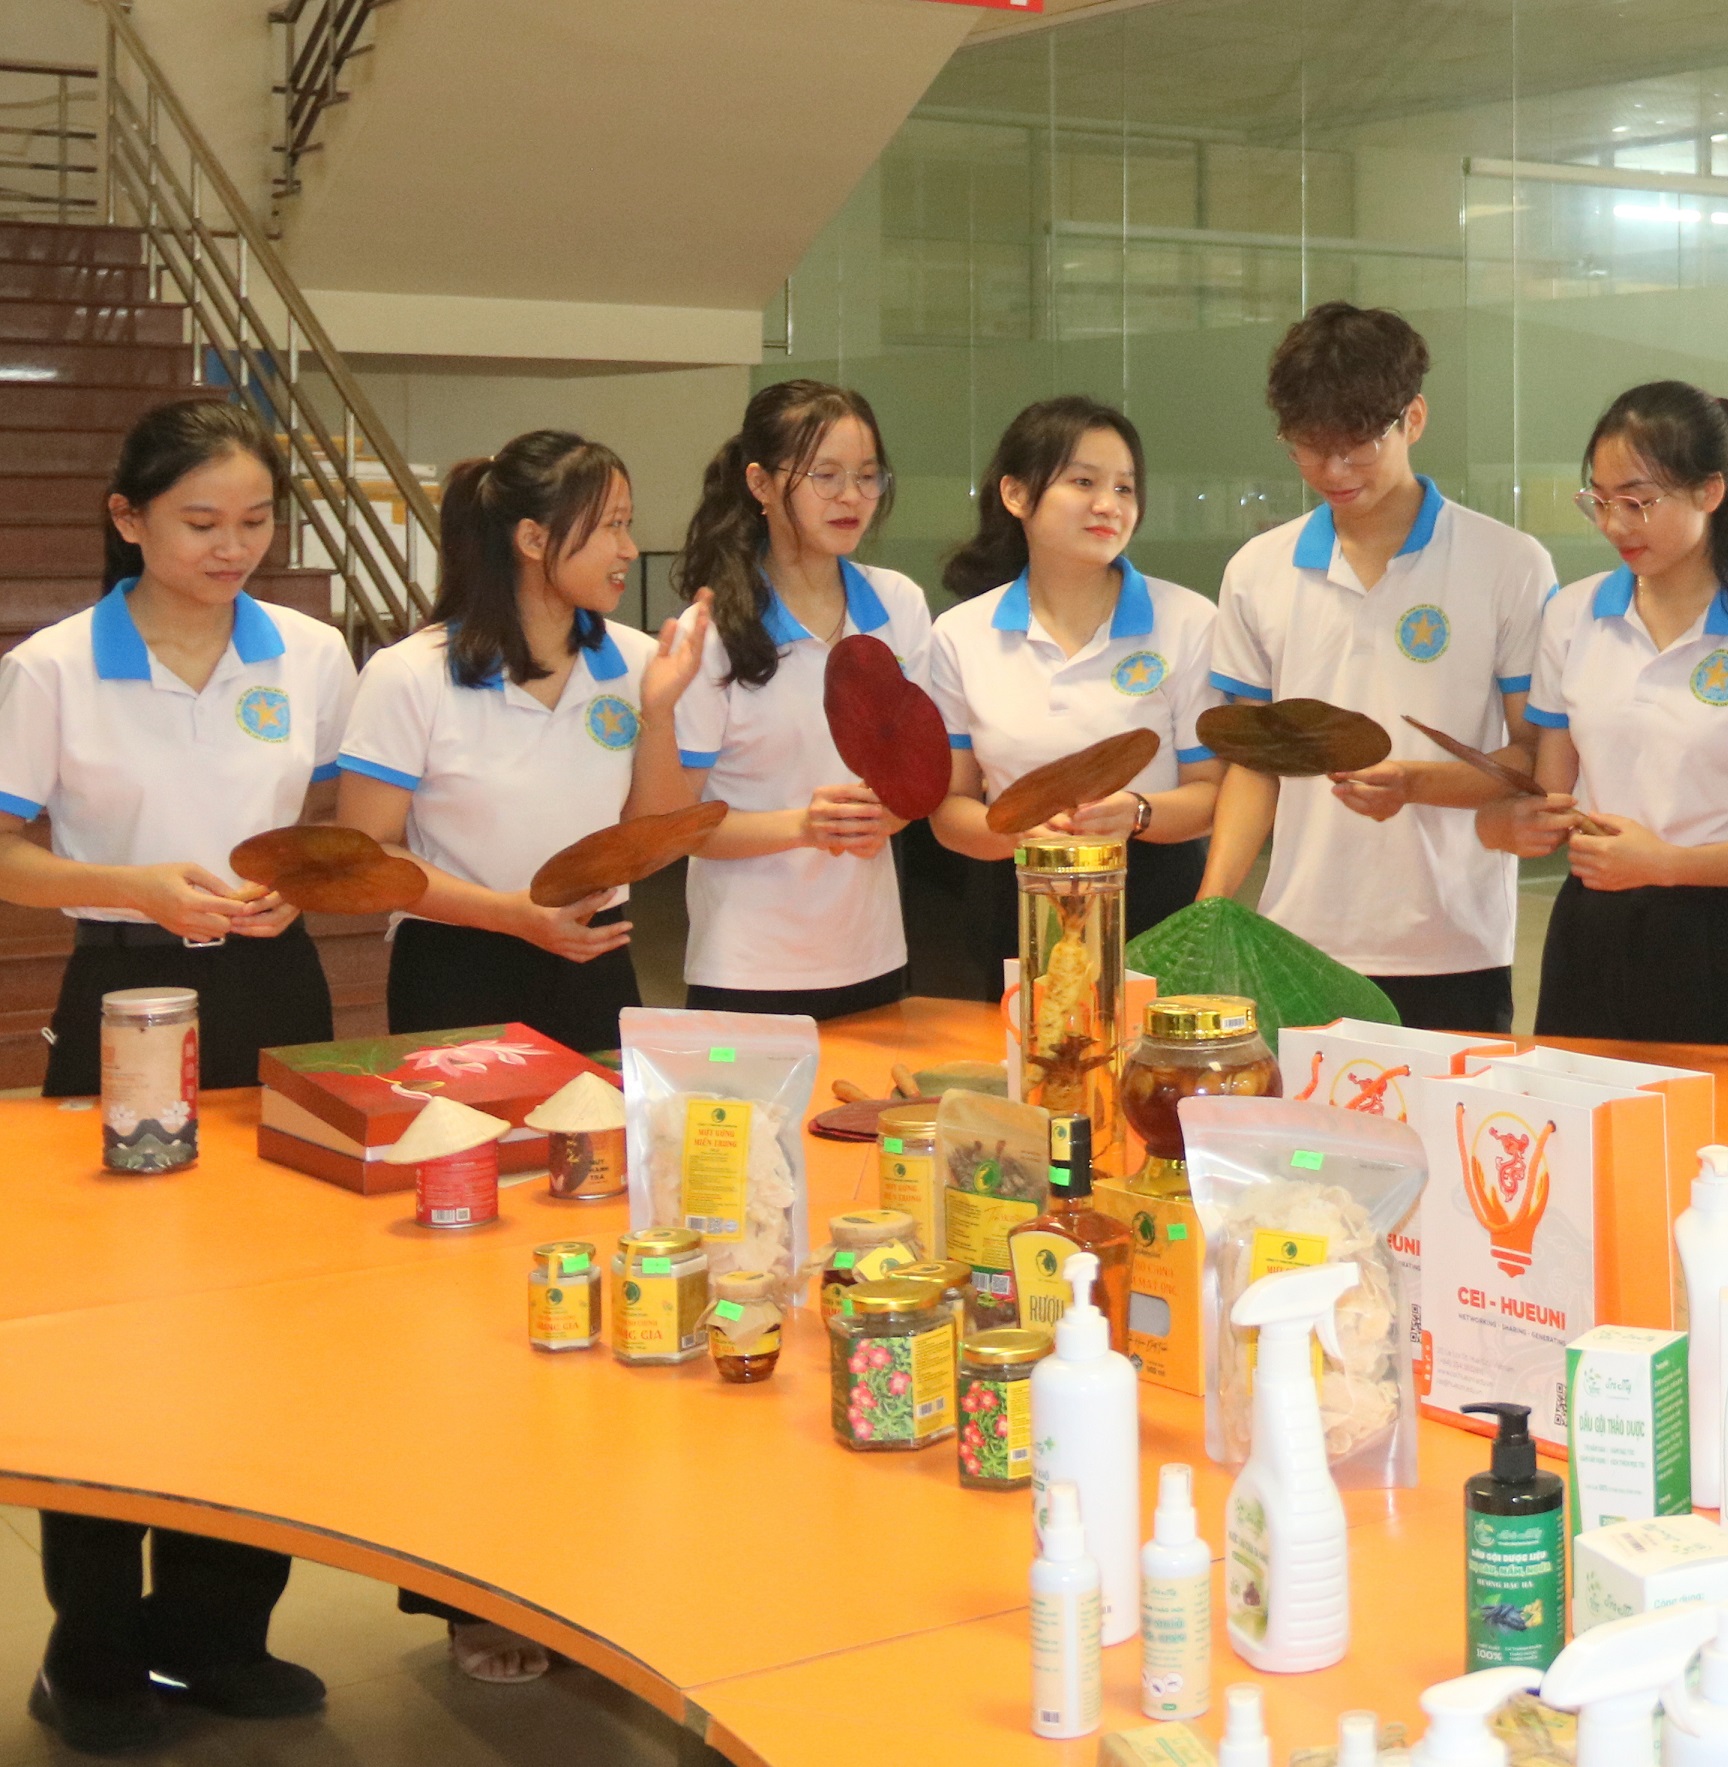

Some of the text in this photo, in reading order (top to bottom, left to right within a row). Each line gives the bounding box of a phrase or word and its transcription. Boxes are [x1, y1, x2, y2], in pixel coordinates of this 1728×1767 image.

[1457, 1286, 1486, 1310] CEI
[1500, 1296, 1566, 1331] HUEUNI
[1476, 1648, 1503, 1662] 100%
